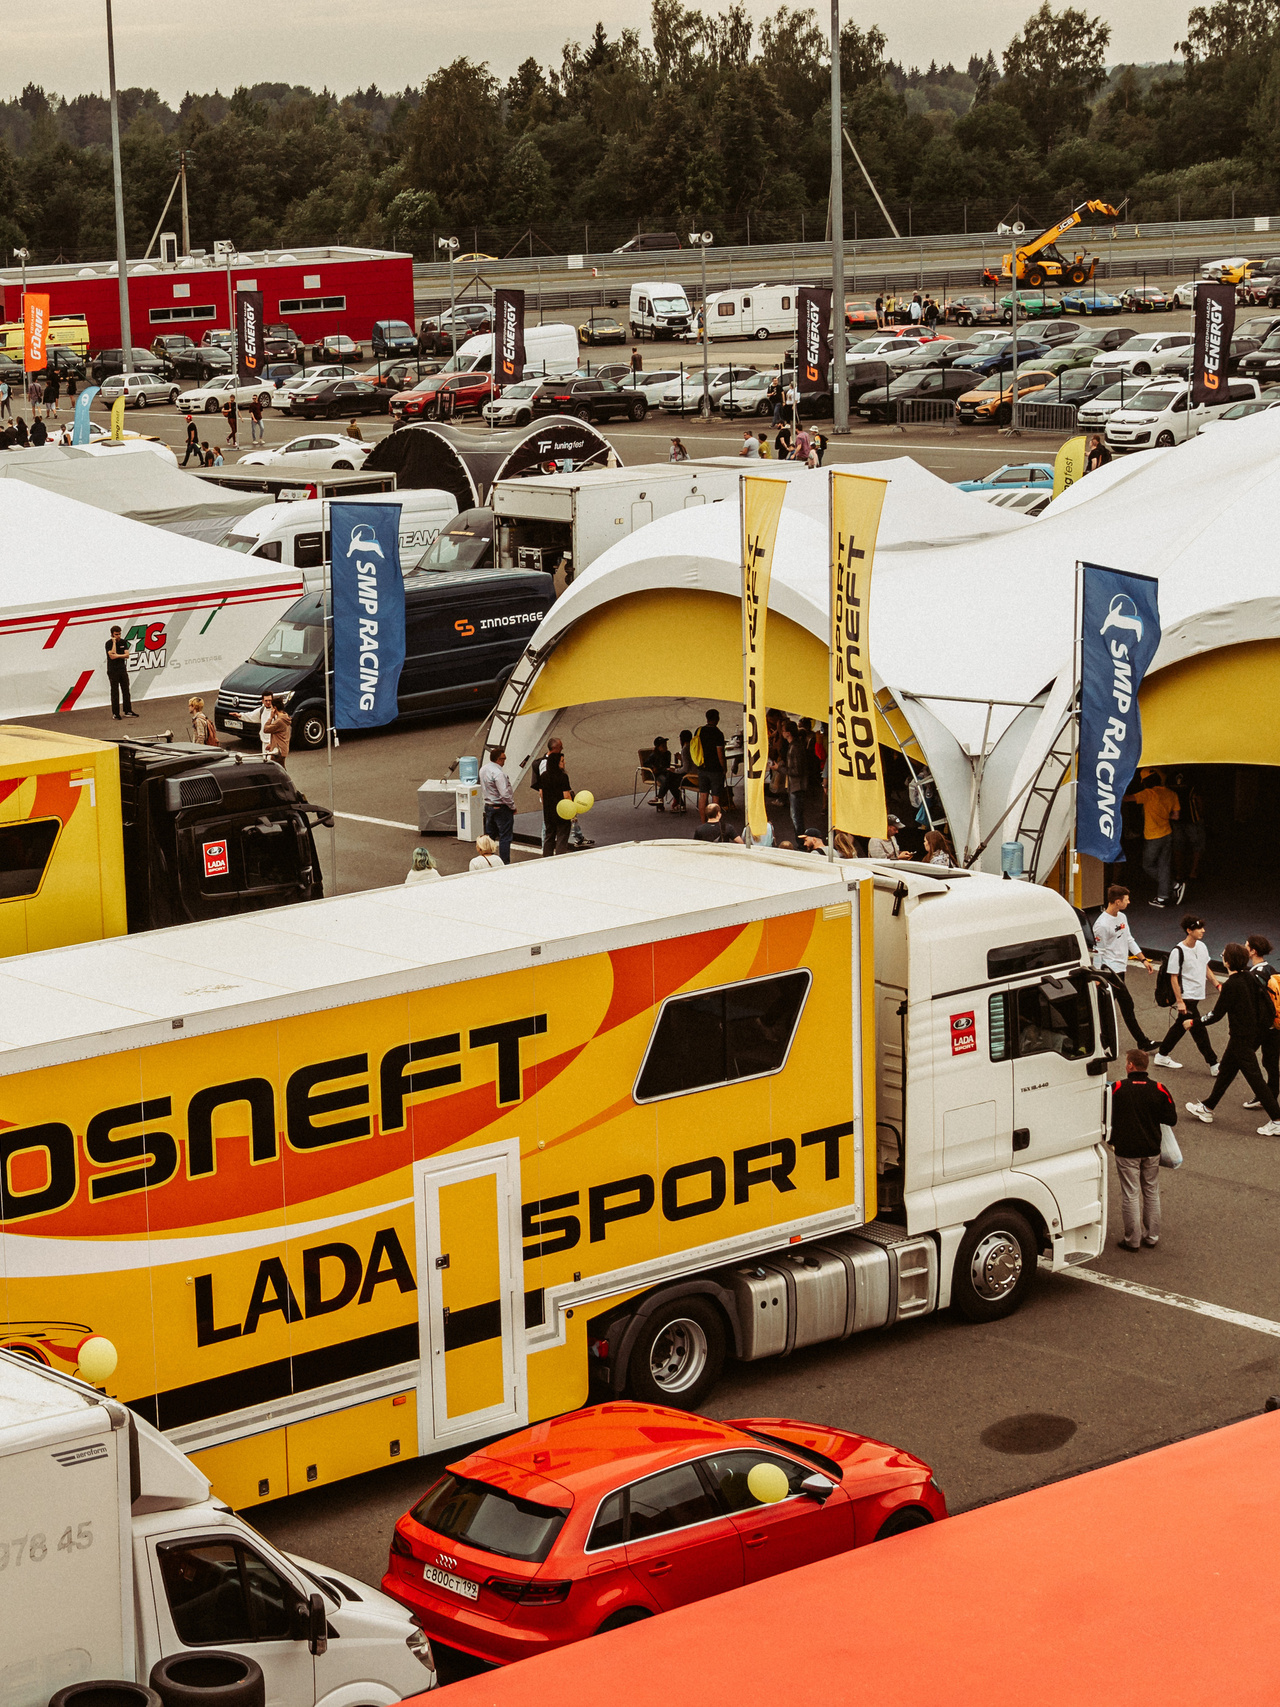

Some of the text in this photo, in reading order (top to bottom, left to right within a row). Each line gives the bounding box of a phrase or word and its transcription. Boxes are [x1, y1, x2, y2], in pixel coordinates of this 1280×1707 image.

[1058, 217, 1074, 232] JCB
[480, 611, 544, 629] INNOSTAGE
[356, 560, 379, 712] SMP RACING
[835, 532, 854, 778] LADA SPORT
[845, 535, 877, 782] ROSNEFT
[1098, 640, 1132, 840] SMP RACING
[208, 860, 226, 868] LADA
[954, 1034, 974, 1046] LADA
[954, 1044, 974, 1052] SPORT
[194, 1121, 854, 1348] LADA SPORT
[76, 1446, 108, 1459] aeroform
[57, 1520, 94, 1554] 45
[462, 1580, 477, 1595] 199
